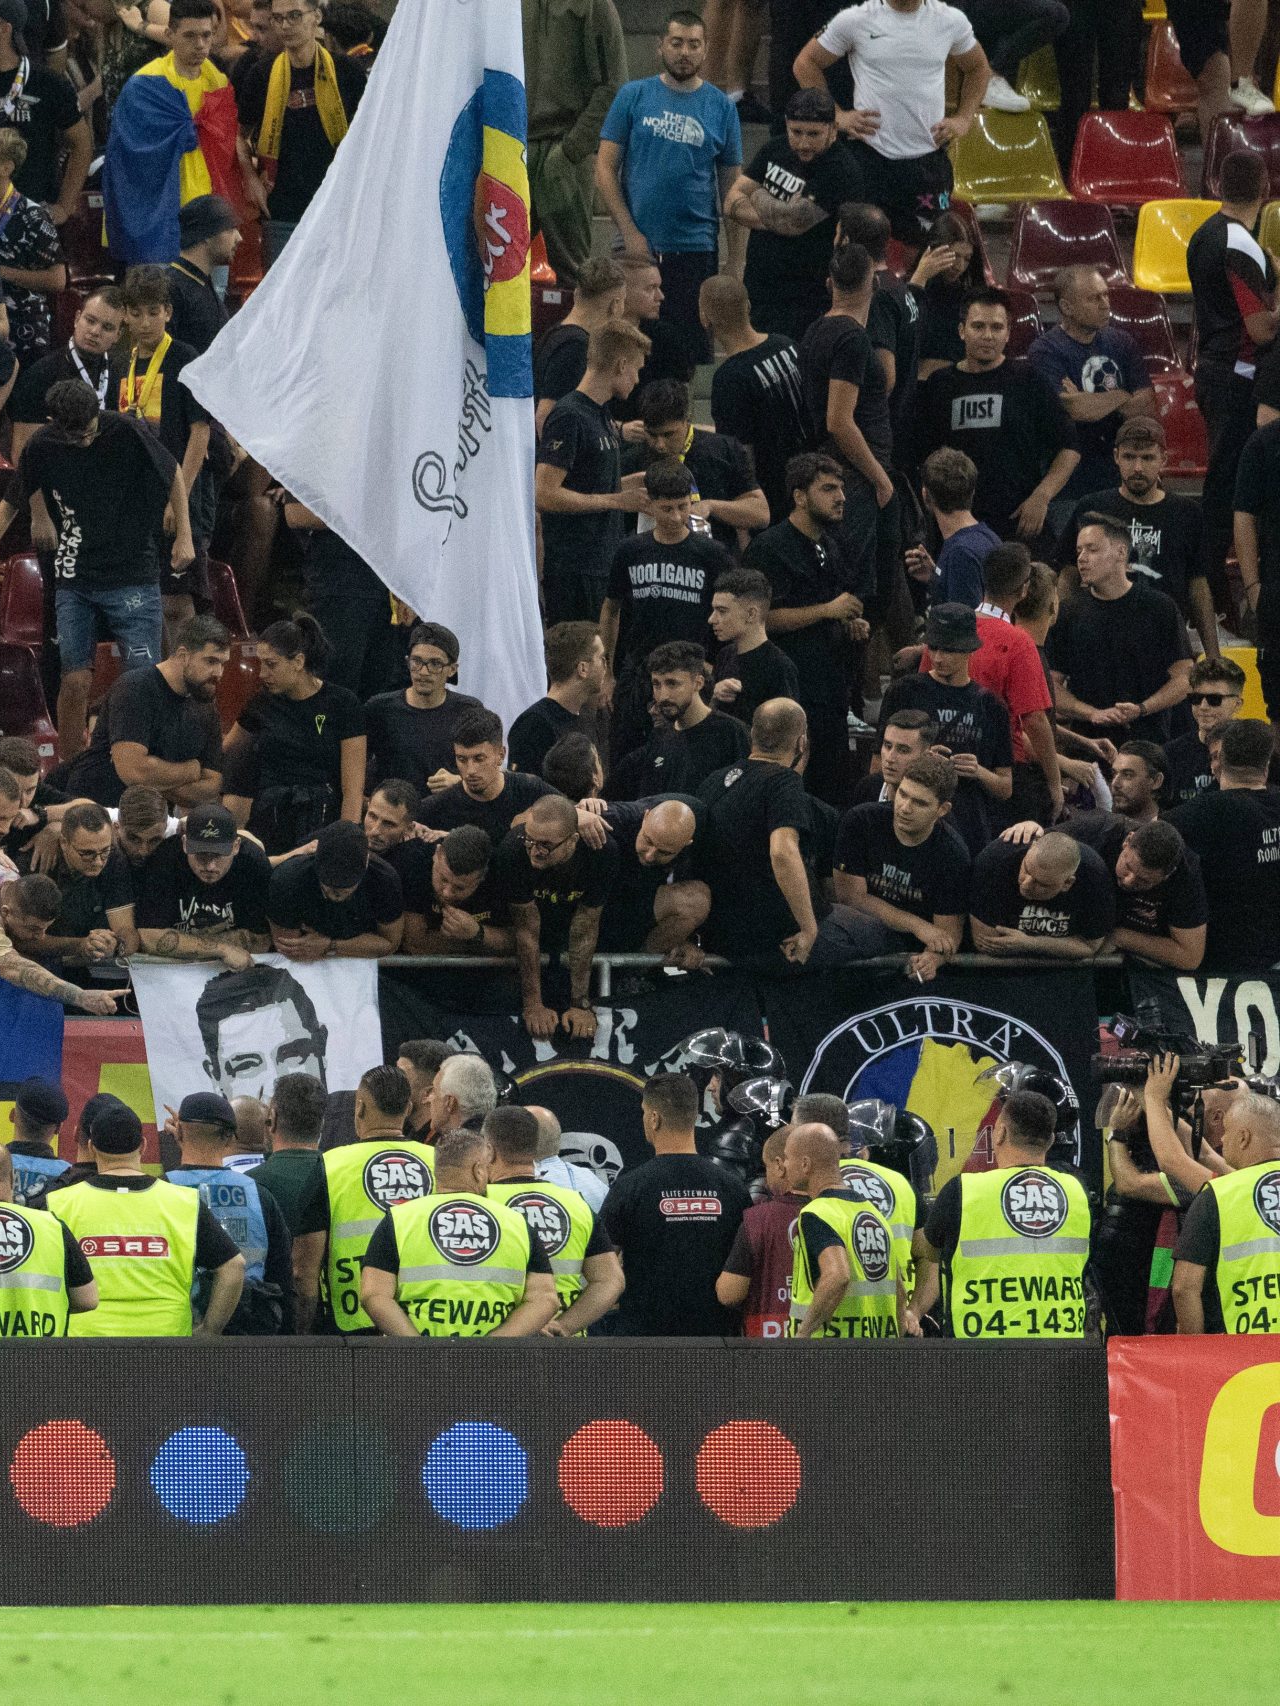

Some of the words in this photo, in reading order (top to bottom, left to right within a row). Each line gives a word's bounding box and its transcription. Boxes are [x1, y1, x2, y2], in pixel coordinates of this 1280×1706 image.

[642, 116, 684, 131] NORTH
[663, 110, 686, 122] THE
[653, 127, 684, 143] FACE
[628, 562, 706, 590] HOOLIGANS
[371, 1163, 424, 1189] SAS
[374, 1186, 424, 1201] TEAM
[661, 1190, 681, 1198] ELITE
[683, 1190, 718, 1198] STEWARD
[1009, 1184, 1059, 1210] SAS
[677, 1202, 717, 1211] SAS
[1011, 1209, 1059, 1223] TEAM
[437, 1212, 490, 1238] SAS
[104, 1241, 164, 1253] SAS
[439, 1236, 490, 1250] TEAM
[856, 1226, 885, 1253] SAS
[861, 1252, 887, 1266] TEAM
[963, 1276, 1085, 1305] STEWARD
[1232, 1273, 1280, 1307] STE
